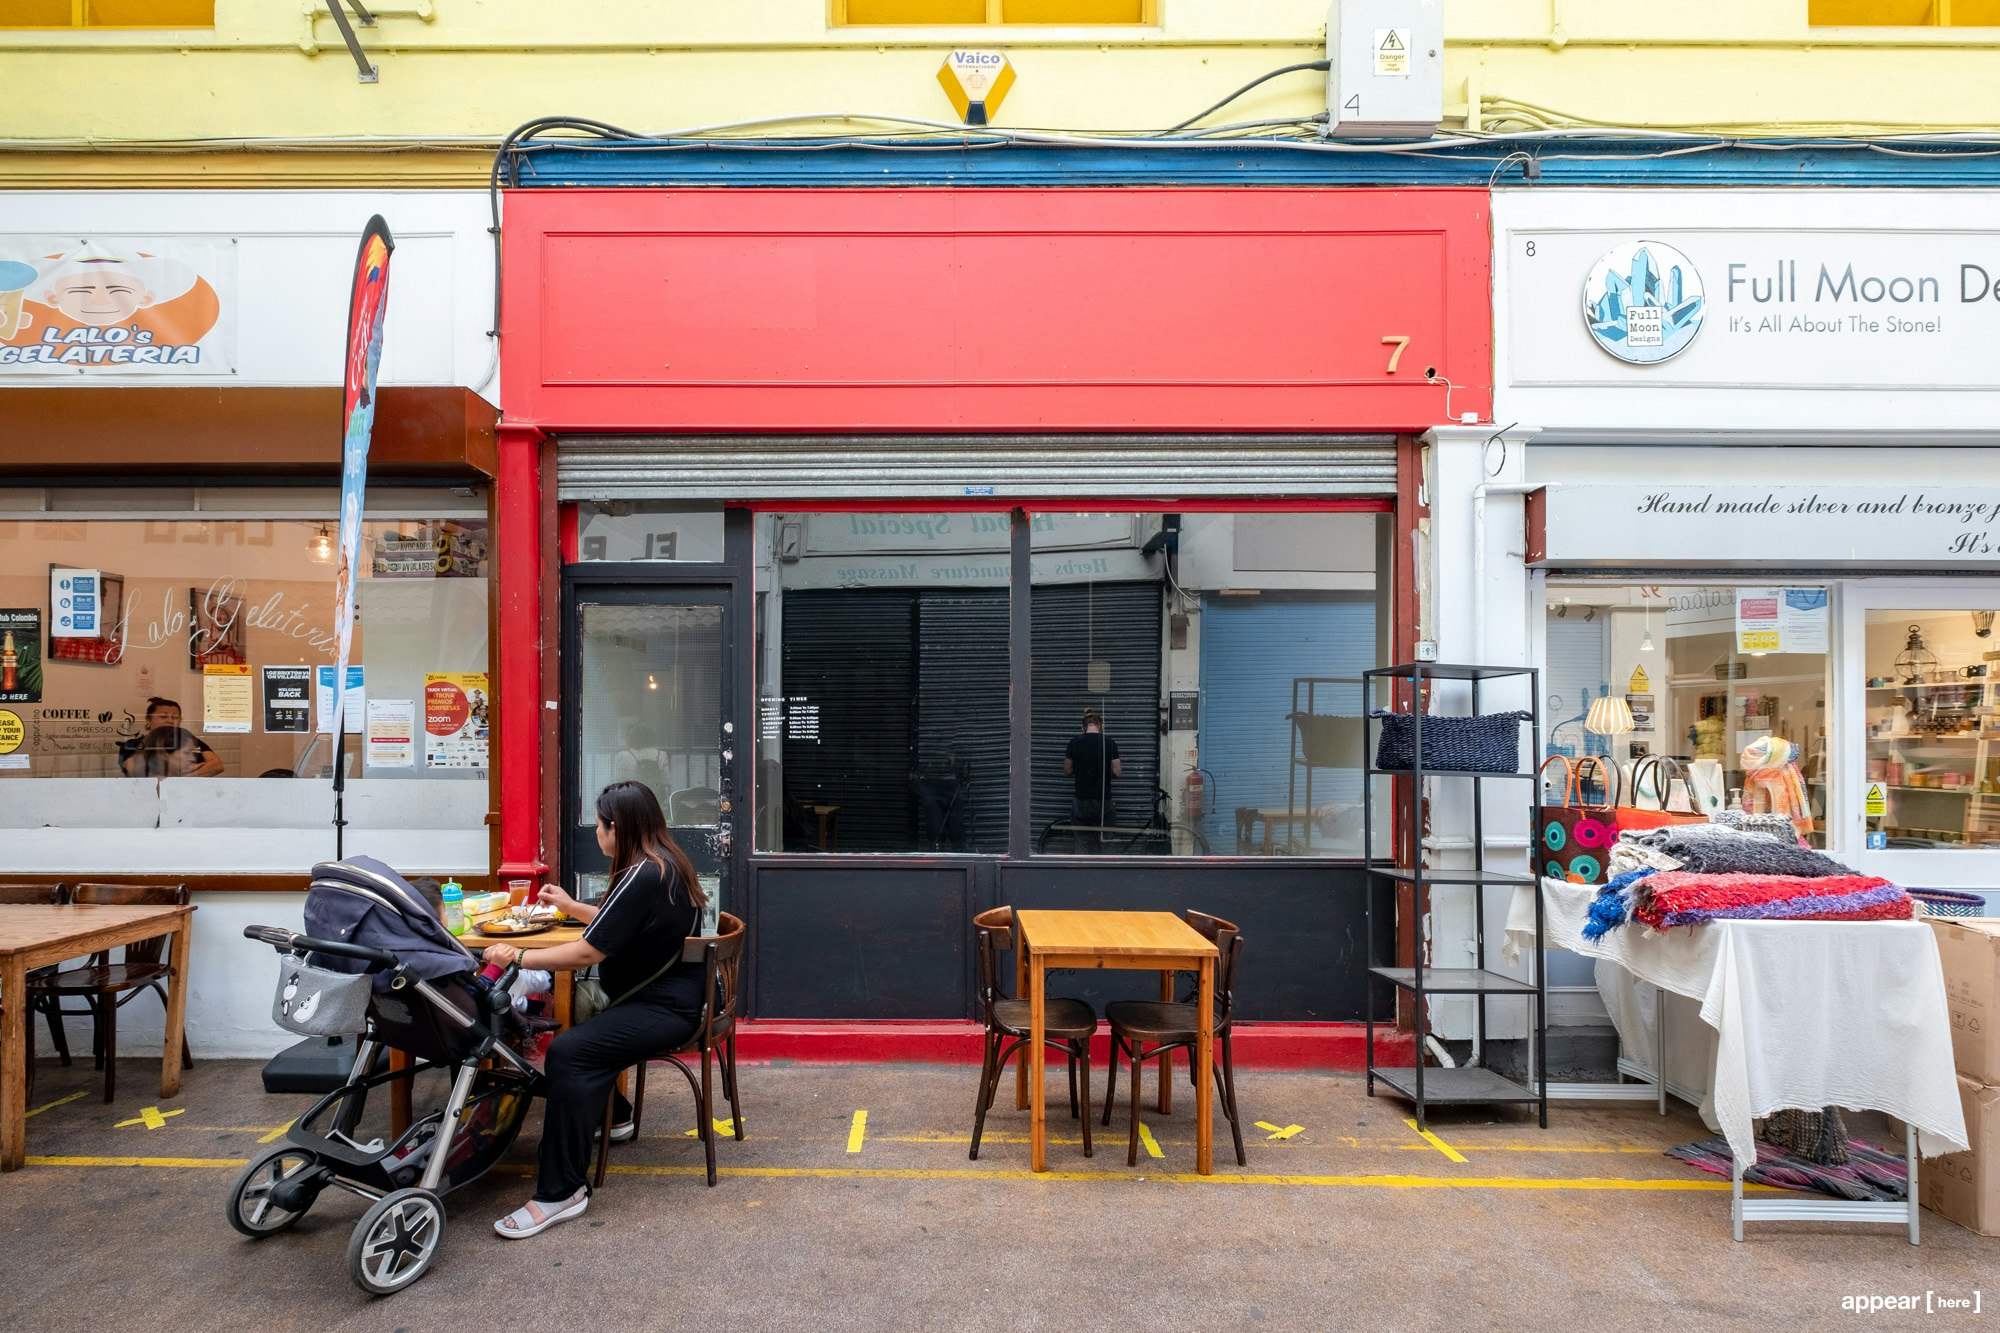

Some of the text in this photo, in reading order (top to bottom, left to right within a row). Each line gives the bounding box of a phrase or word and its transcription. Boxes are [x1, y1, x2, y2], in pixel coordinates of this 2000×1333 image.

[954, 51, 1000, 64] Vaico
[1344, 93, 1360, 117] 4
[1525, 241, 1537, 258] 8
[1728, 260, 1796, 303] Full
[1815, 263, 1940, 304] Moon
[1629, 309, 1660, 320] Full
[1629, 324, 1660, 332] Moon
[1728, 315, 1942, 334] It's All About The Stone!
[1630, 335, 1661, 343] Designs
[0, 344, 201, 365] GELATERIA
[1381, 335, 1411, 374] 7
[1637, 490, 1714, 514] Hand
[1716, 492, 1786, 514] made
[1786, 492, 1851, 514] silver
[1856, 494, 1908, 514] and
[1912, 494, 1993, 524] bronze
[1948, 532, 1995, 554] It's
[43, 709, 90, 719] COFFEE
